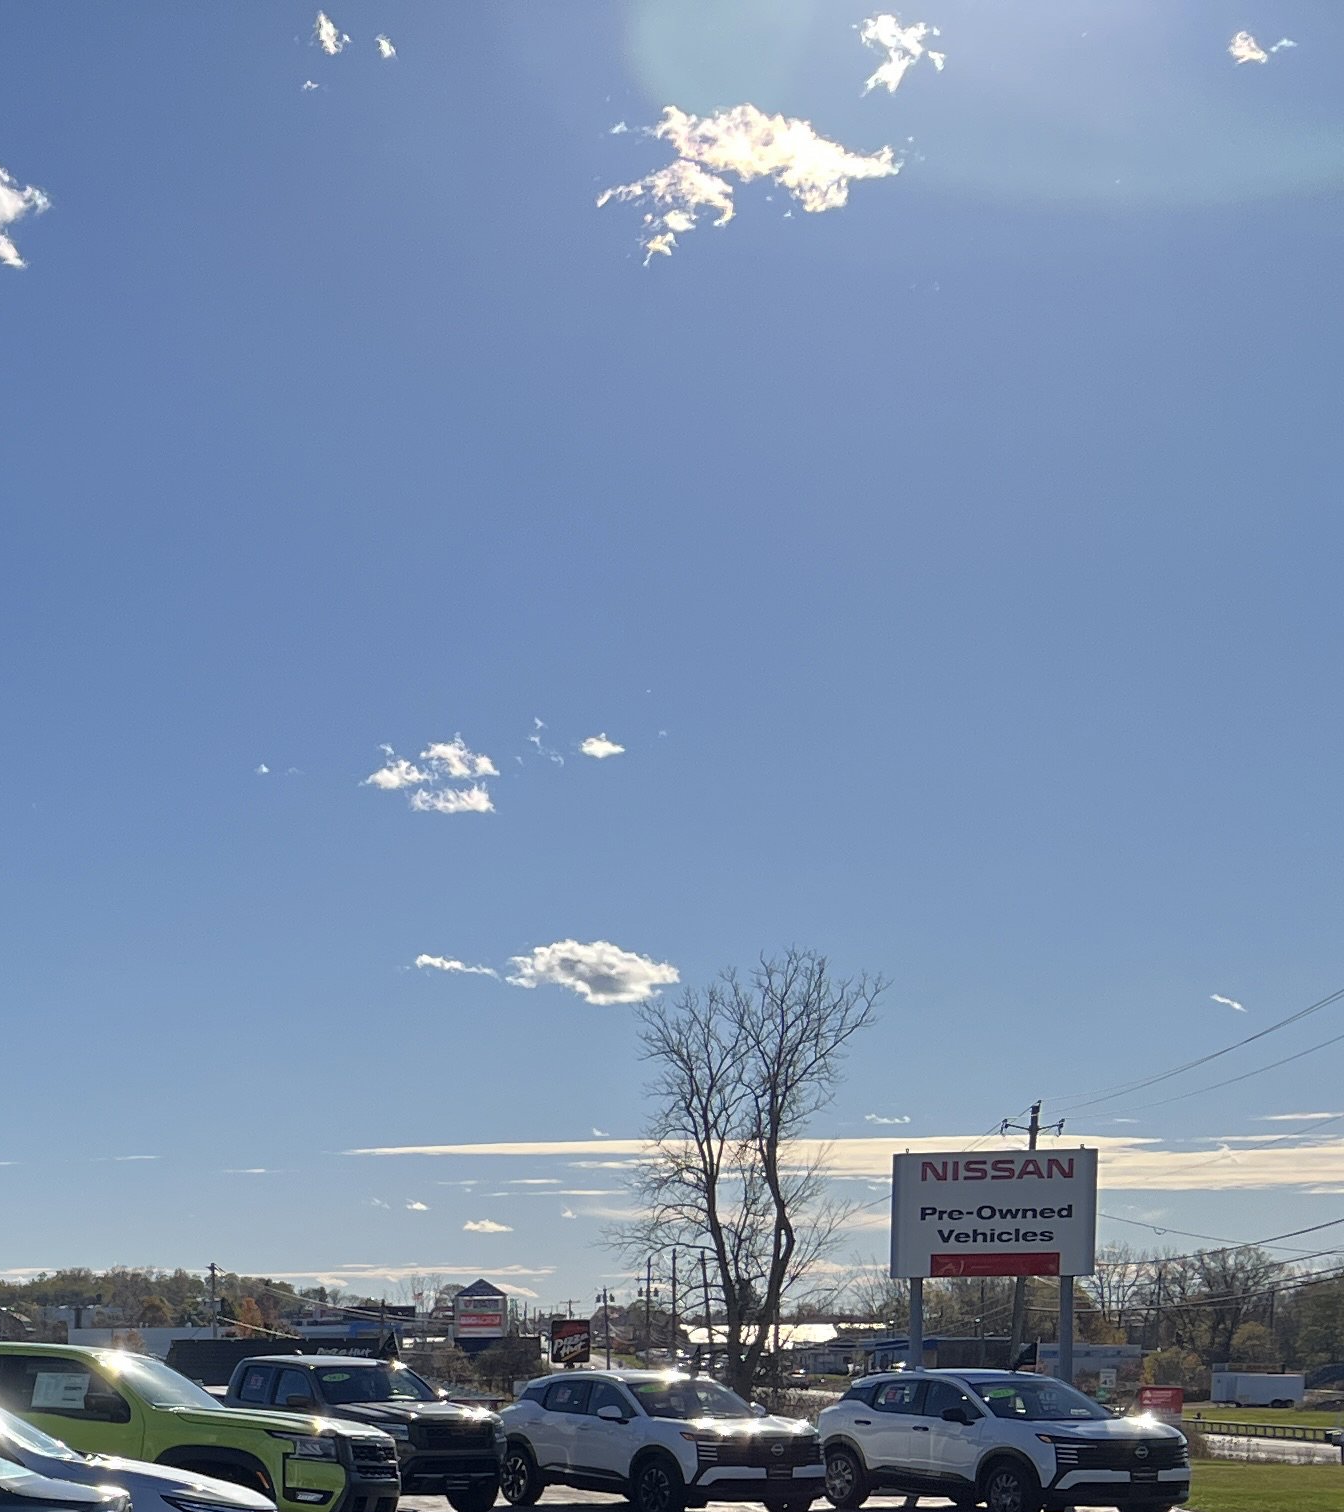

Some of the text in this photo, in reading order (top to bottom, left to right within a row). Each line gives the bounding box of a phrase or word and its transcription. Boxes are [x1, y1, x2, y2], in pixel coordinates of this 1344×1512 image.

[921, 1158, 1074, 1181] NISSAN
[920, 1204, 1073, 1221] Pre-Owned
[937, 1228, 1054, 1243] Vehicles
